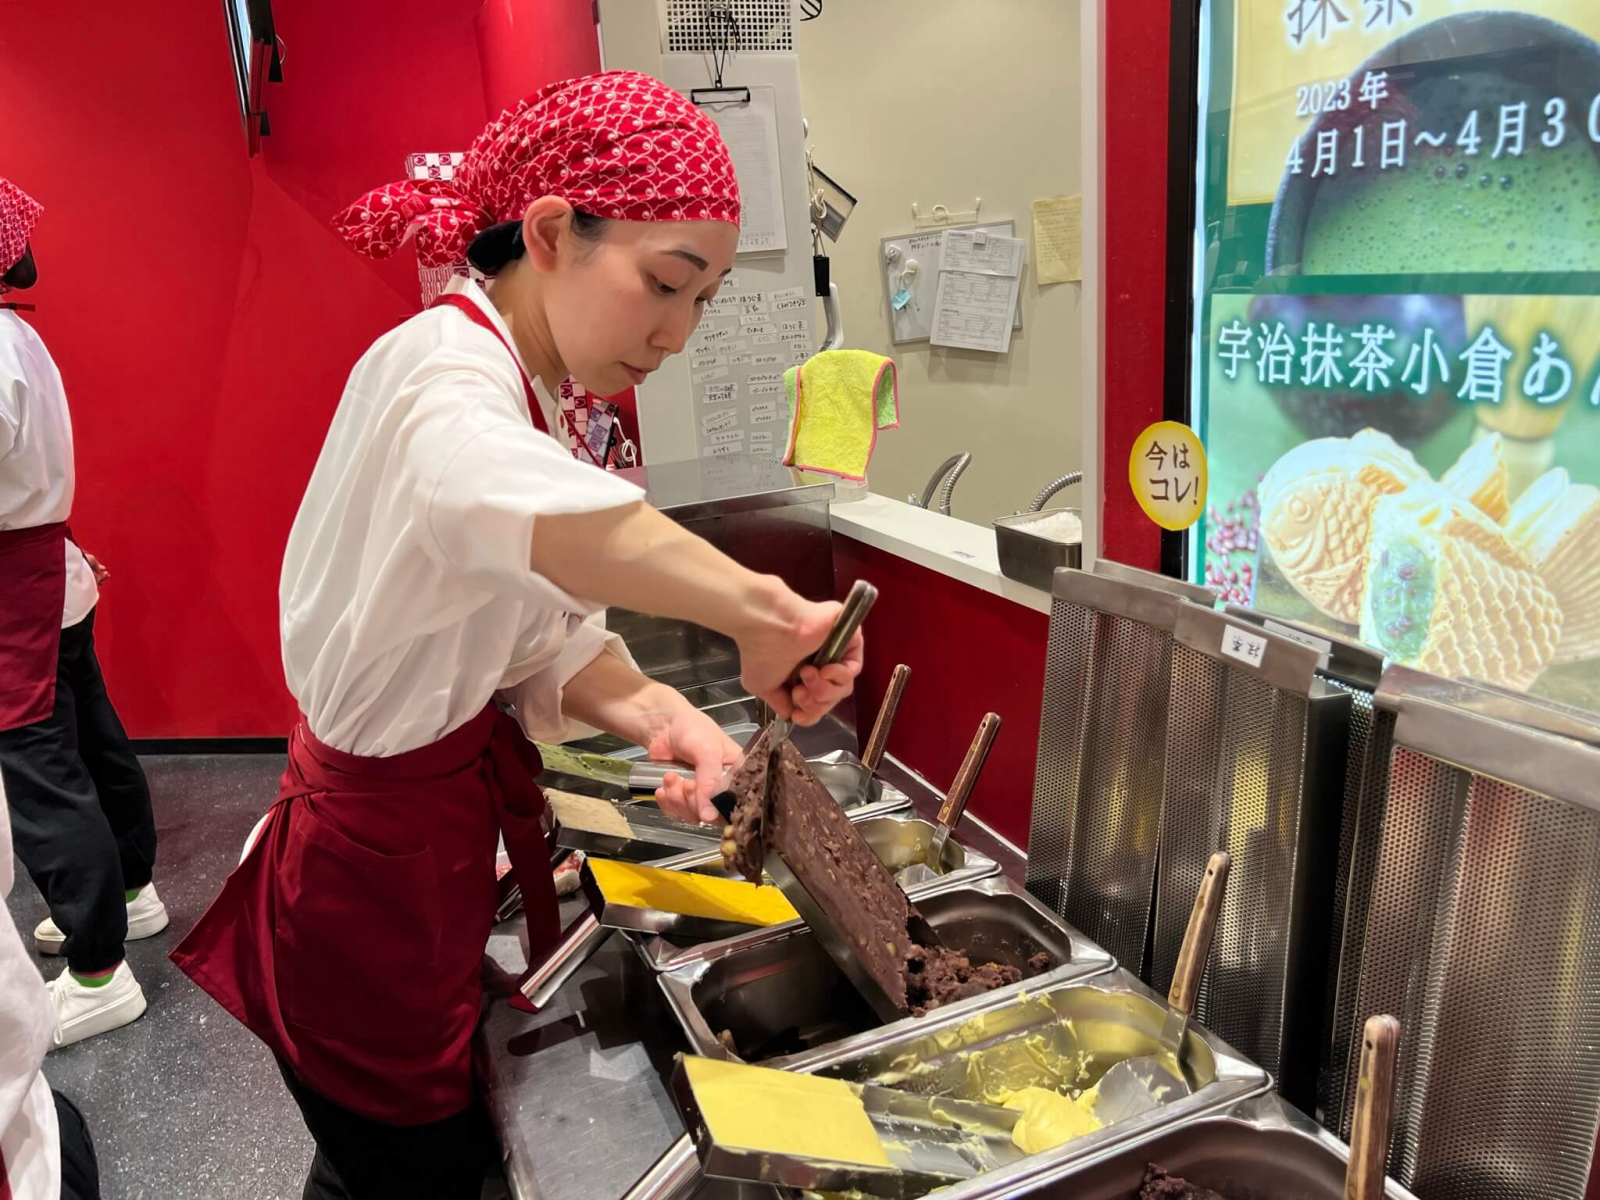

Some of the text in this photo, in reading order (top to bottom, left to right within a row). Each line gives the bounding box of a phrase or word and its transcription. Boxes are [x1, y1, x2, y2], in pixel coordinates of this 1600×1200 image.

[1218, 320, 1600, 405] 宇治抹茶小倉あ
[1145, 441, 1190, 470] 今は
[1149, 476, 1199, 505] コレ!
